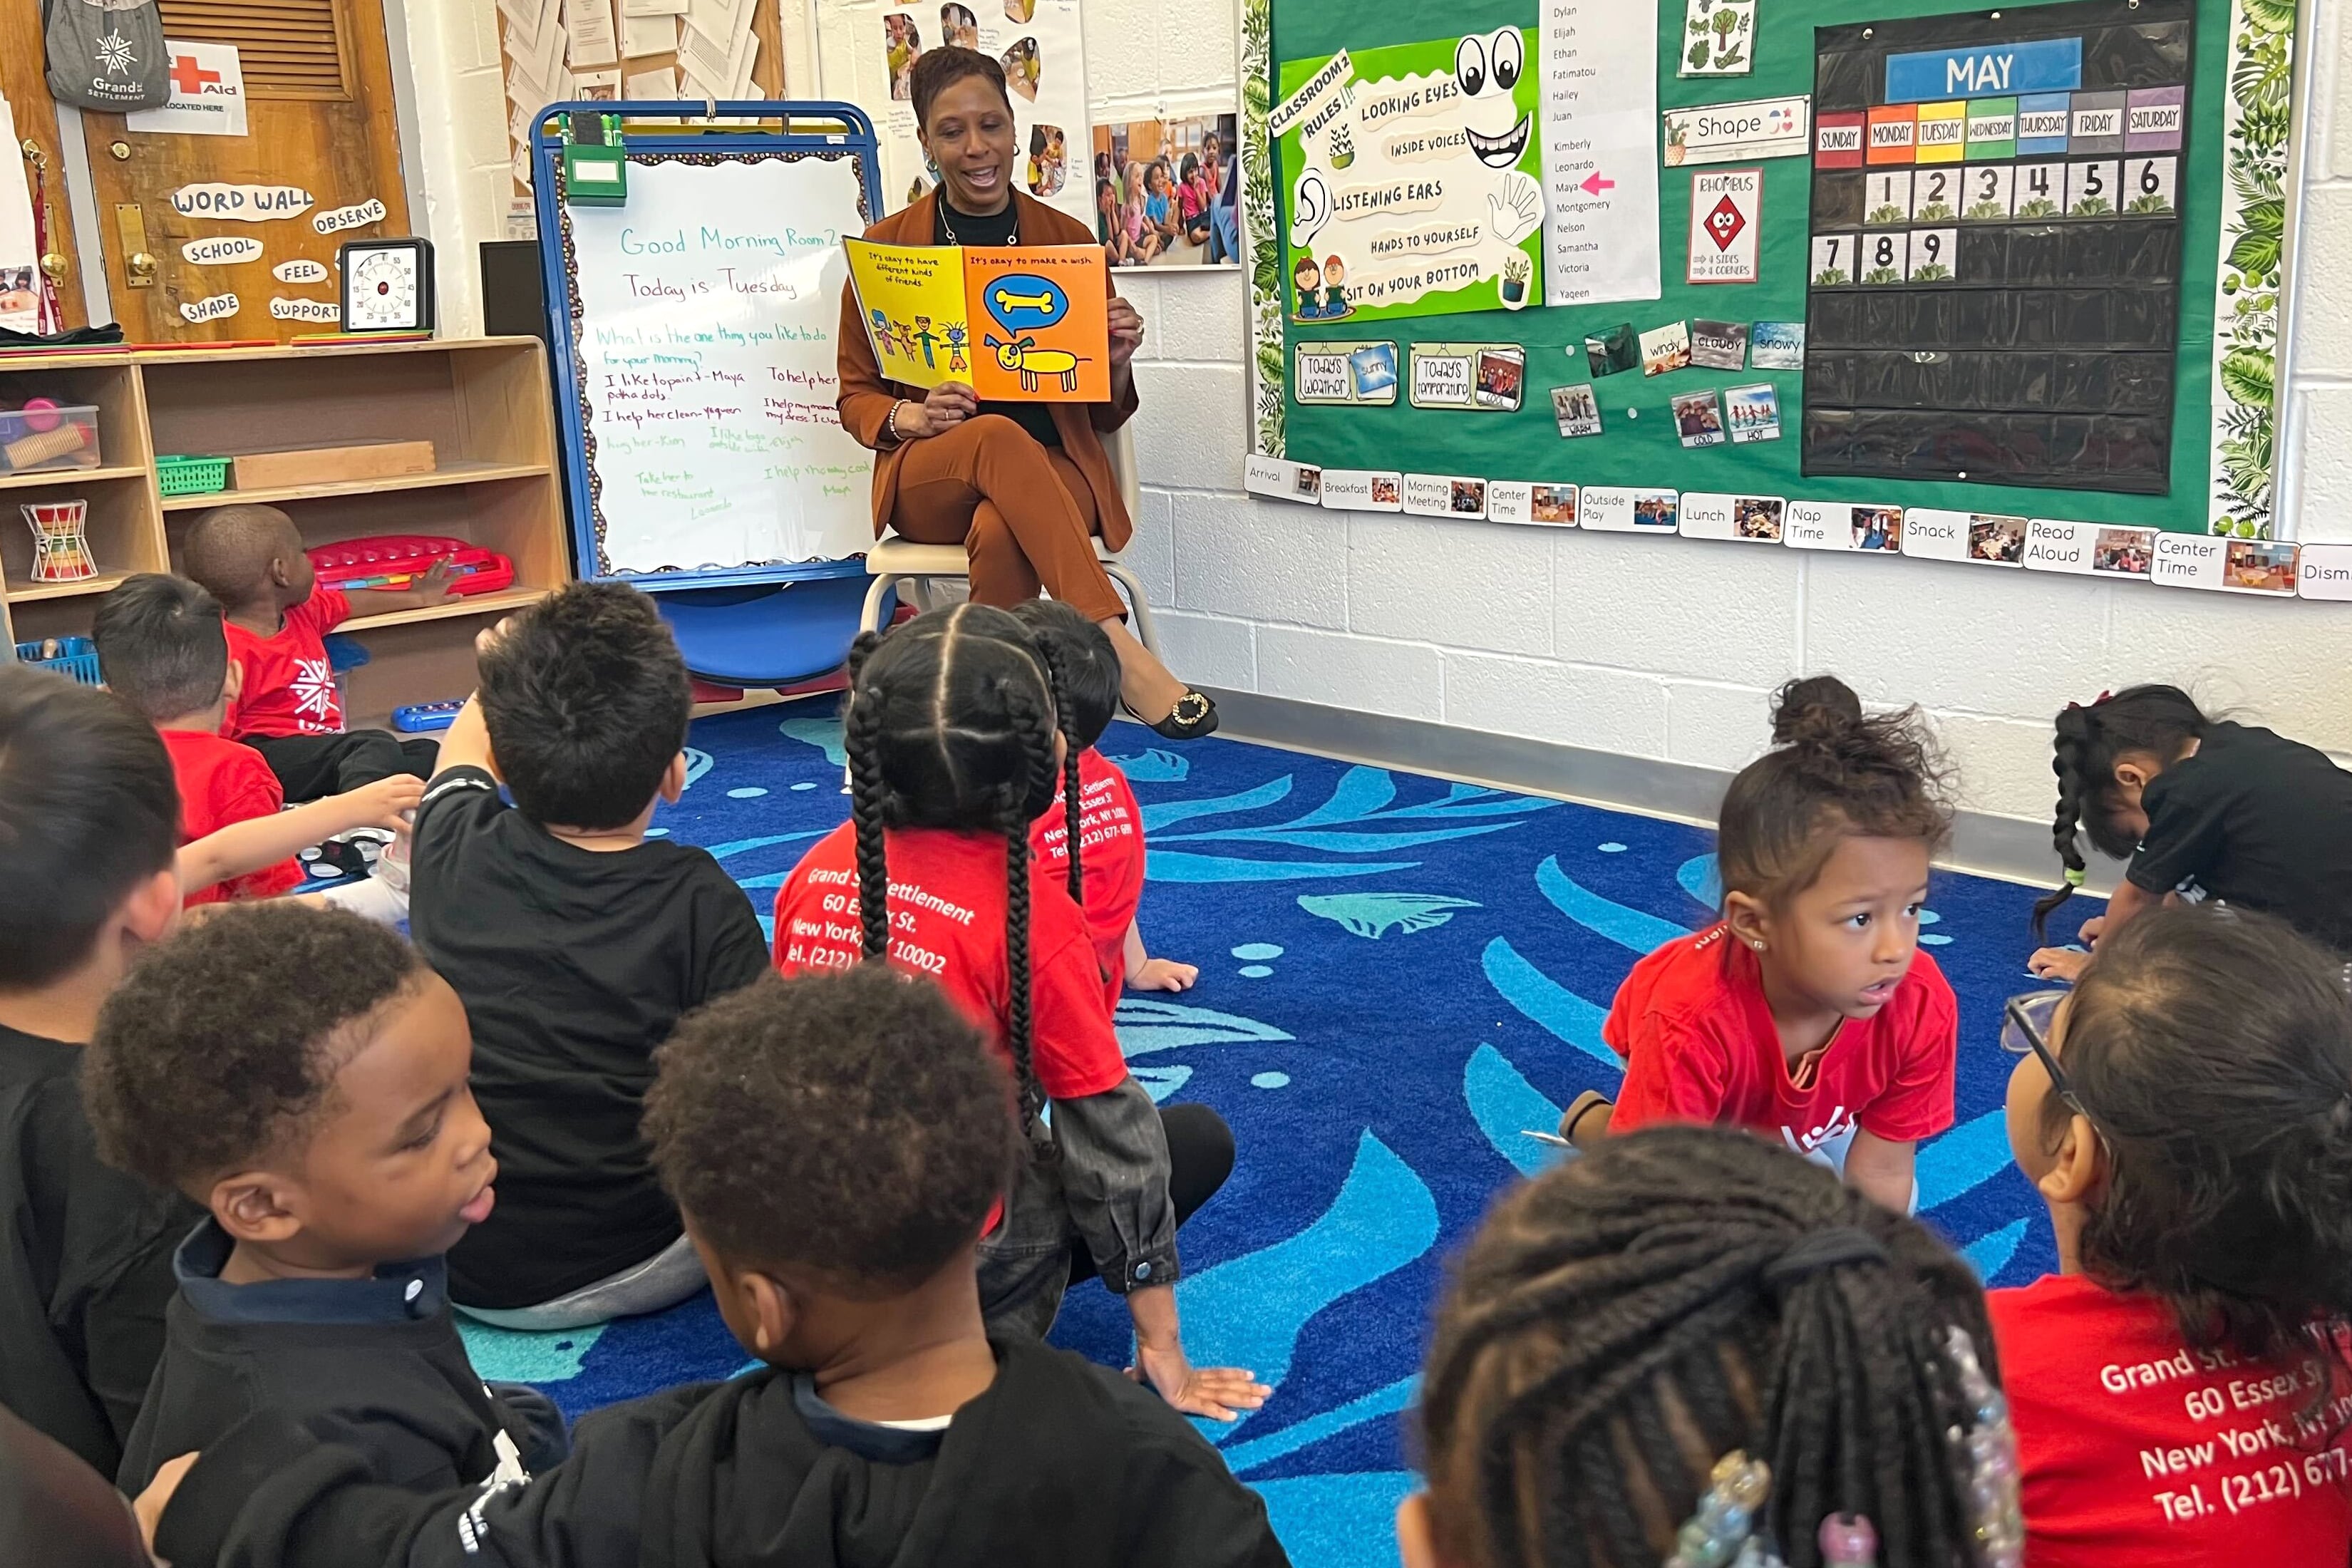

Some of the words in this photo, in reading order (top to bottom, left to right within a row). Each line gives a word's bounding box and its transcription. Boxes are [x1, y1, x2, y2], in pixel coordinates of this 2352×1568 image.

[1554, 6, 1577, 19] Dylan
[1554, 27, 1576, 40] Elijah
[1553, 48, 1577, 60] Ethan
[1552, 67, 1597, 80] Fatimatou
[1946, 53, 2013, 93] MAY
[88, 88, 145, 100] SETTLEMENT
[93, 78, 136, 93] Grand
[1270, 61, 1343, 129] CLASSROOM
[1341, 56, 1350, 68] 2
[1361, 95, 1420, 122] LOOKING
[1425, 81, 1458, 105] EYES
[1552, 89, 1579, 102] Hailey
[165, 103, 201, 111] LOCATED
[1552, 112, 1572, 122] Juan
[1698, 116, 1761, 138] Shape
[1821, 130, 1857, 149] SUNDAY
[1873, 123, 1911, 143] MONDAY
[1922, 121, 1961, 142] TUESDAY
[1969, 120, 2012, 138] WEDNESDAY
[2020, 114, 2067, 135] THURSDAY
[2080, 113, 2114, 133] FRIDAY
[2130, 109, 2179, 128] SATURDAY
[1391, 142, 1424, 157] INSIDE
[1428, 133, 1466, 151] VOICES
[1554, 139, 1591, 152] Kimberly
[1555, 160, 1594, 172] Leonardo
[1555, 183, 1579, 195] Maya
[1700, 176, 1753, 192] RHOMBUS
[1884, 176, 1891, 202] 1
[1928, 172, 1946, 202] 2
[1979, 169, 1998, 200] 3
[2030, 167, 2049, 196] 4
[2083, 164, 2103, 196] 5
[2140, 160, 2160, 194] 6
[173, 190, 244, 212] WORD
[254, 190, 314, 210] WALL
[1334, 188, 1401, 212] LISTENING
[1408, 180, 1442, 201] EARS
[1557, 200, 1611, 214] Montgomery
[316, 202, 383, 232] OBSERVE
[1557, 222, 1585, 234] Nelson
[621, 228, 686, 254] Good
[701, 227, 785, 256] Morning
[786, 228, 824, 246] Room
[824, 229, 840, 246] 2
[1371, 237, 1403, 254] HANDS
[1407, 235, 1420, 248] TO
[1424, 226, 1480, 245] YOURSELF
[1557, 241, 1599, 254] Samantha
[191, 239, 255, 262] SCHOOL
[1716, 254, 1739, 264] SIDES
[1827, 239, 1840, 267] 7
[1875, 237, 1894, 267] 8
[1924, 234, 1941, 263] 9
[884, 256, 902, 265] okay
[917, 257, 939, 266] have
[971, 257, 987, 265] It's
[990, 257, 1012, 267] okay
[1558, 262, 1589, 274] Victoria
[284, 264, 320, 281] FEEL
[912, 267, 932, 277] kinds
[1716, 265, 1750, 275] CORNERS
[622, 274, 686, 303] Today
[691, 277, 709, 294] is
[717, 268, 798, 300] Tuesday
[1346, 284, 1364, 301] SIT
[1368, 283, 1385, 297] ON
[1388, 275, 1422, 296] YOUR
[1426, 262, 1479, 284] BOTTOM
[1559, 289, 1589, 299] Yaqeen
[188, 295, 237, 320] SHADE
[273, 304, 339, 319] SUPPORT
[596, 326, 644, 346] What
[650, 332, 661, 344] is
[665, 323, 691, 344] the
[693, 333, 714, 343] one
[749, 331, 773, 346] you
[775, 323, 798, 341] like
[1650, 340, 1681, 357] windy
[1698, 338, 1741, 351] CLOUDY
[1759, 338, 1800, 353] snowy
[622, 356, 650, 369] your
[1361, 359, 1387, 376] sunny
[604, 374, 615, 387] I
[621, 373, 649, 387] like
[1304, 378, 1346, 396] weather
[1417, 383, 1468, 396] temperature
[602, 411, 613, 423] I
[616, 411, 643, 429] help
[1569, 425, 1592, 435] WARM
[1747, 430, 1764, 441] HOT
[1693, 434, 1713, 445] COLD
[1249, 467, 1281, 483] Arrival
[1324, 481, 1368, 495] Breakfast
[1408, 480, 1448, 497] Morning
[1492, 488, 1526, 501] Center
[1408, 495, 1446, 511] Meeting
[1584, 493, 1625, 507] Outside
[1491, 503, 1516, 515] Time
[1583, 507, 1604, 522] Play
[1686, 507, 1726, 522] Lunch
[1792, 507, 1821, 525] Nap
[1790, 524, 1825, 540] Time
[1908, 521, 1955, 540] Snack
[2031, 522, 2074, 541] Read
[2029, 543, 2079, 563] Aloud
[2159, 539, 2217, 559] Center
[2157, 558, 2197, 577] Time
[2304, 564, 2352, 580] Dism
[808, 867, 851, 884] Grand
[822, 893, 845, 912] 60
[886, 877, 975, 926] ettlement
[792, 918, 822, 937] New
[895, 911, 917, 933] St.
[810, 945, 853, 971] (212)
[893, 940, 947, 974] 10002
[2100, 1348, 2194, 1393] Grand
[2185, 1387, 2225, 1422] 60
[2228, 1373, 2301, 1410] Essex
[2140, 1441, 2214, 1480] New
[2217, 1418, 2294, 1459] York,
[2153, 1484, 2215, 1523] Tel.
[2221, 1461, 2301, 1515] (212)
